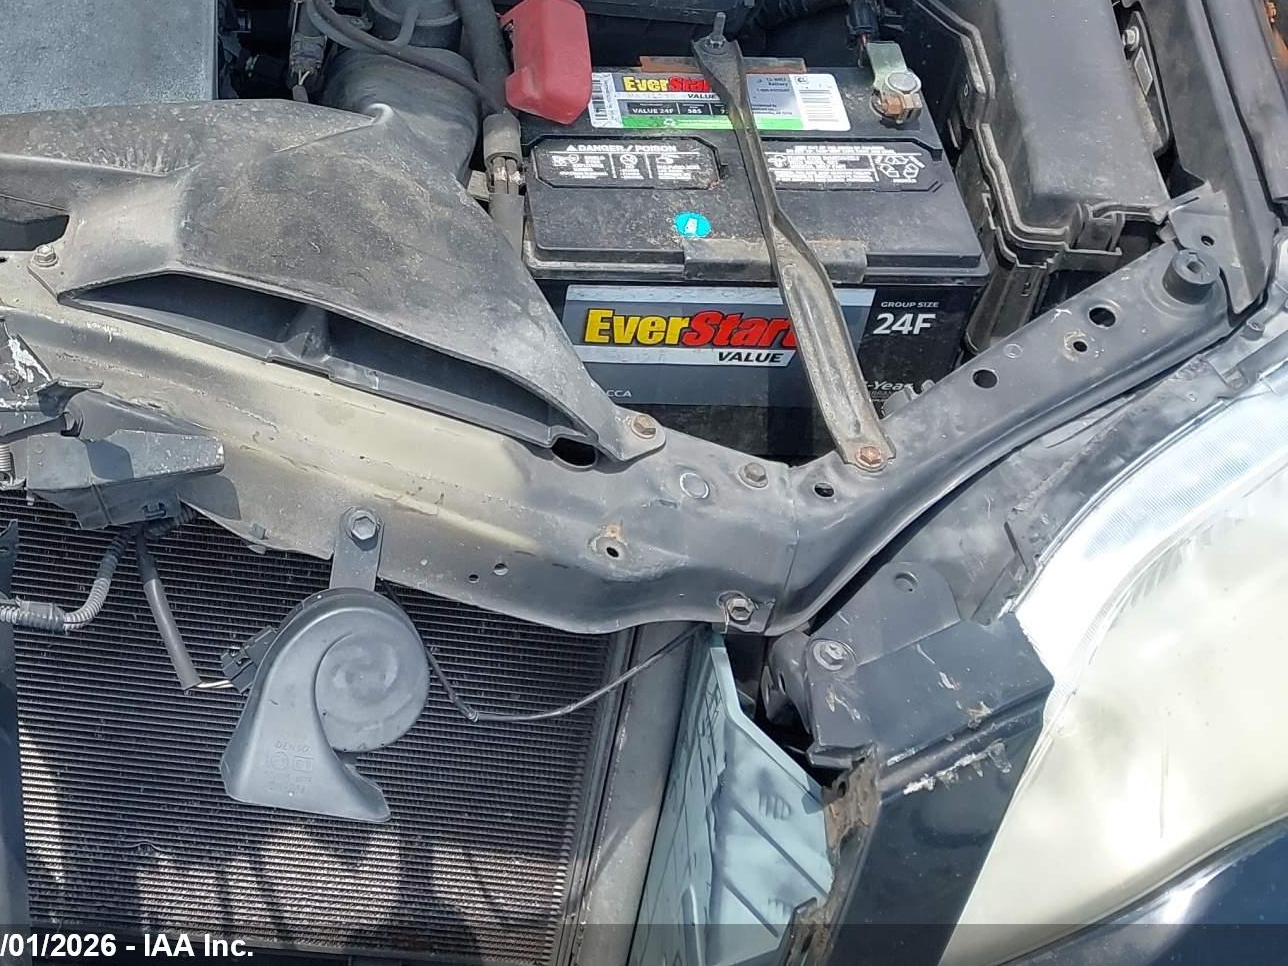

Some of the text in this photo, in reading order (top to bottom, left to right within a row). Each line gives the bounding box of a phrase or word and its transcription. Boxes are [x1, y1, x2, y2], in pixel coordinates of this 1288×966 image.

[873, 313, 937, 335] 24F
[718, 351, 784, 363] VALUE
[606, 389, 632, 397] CCA
